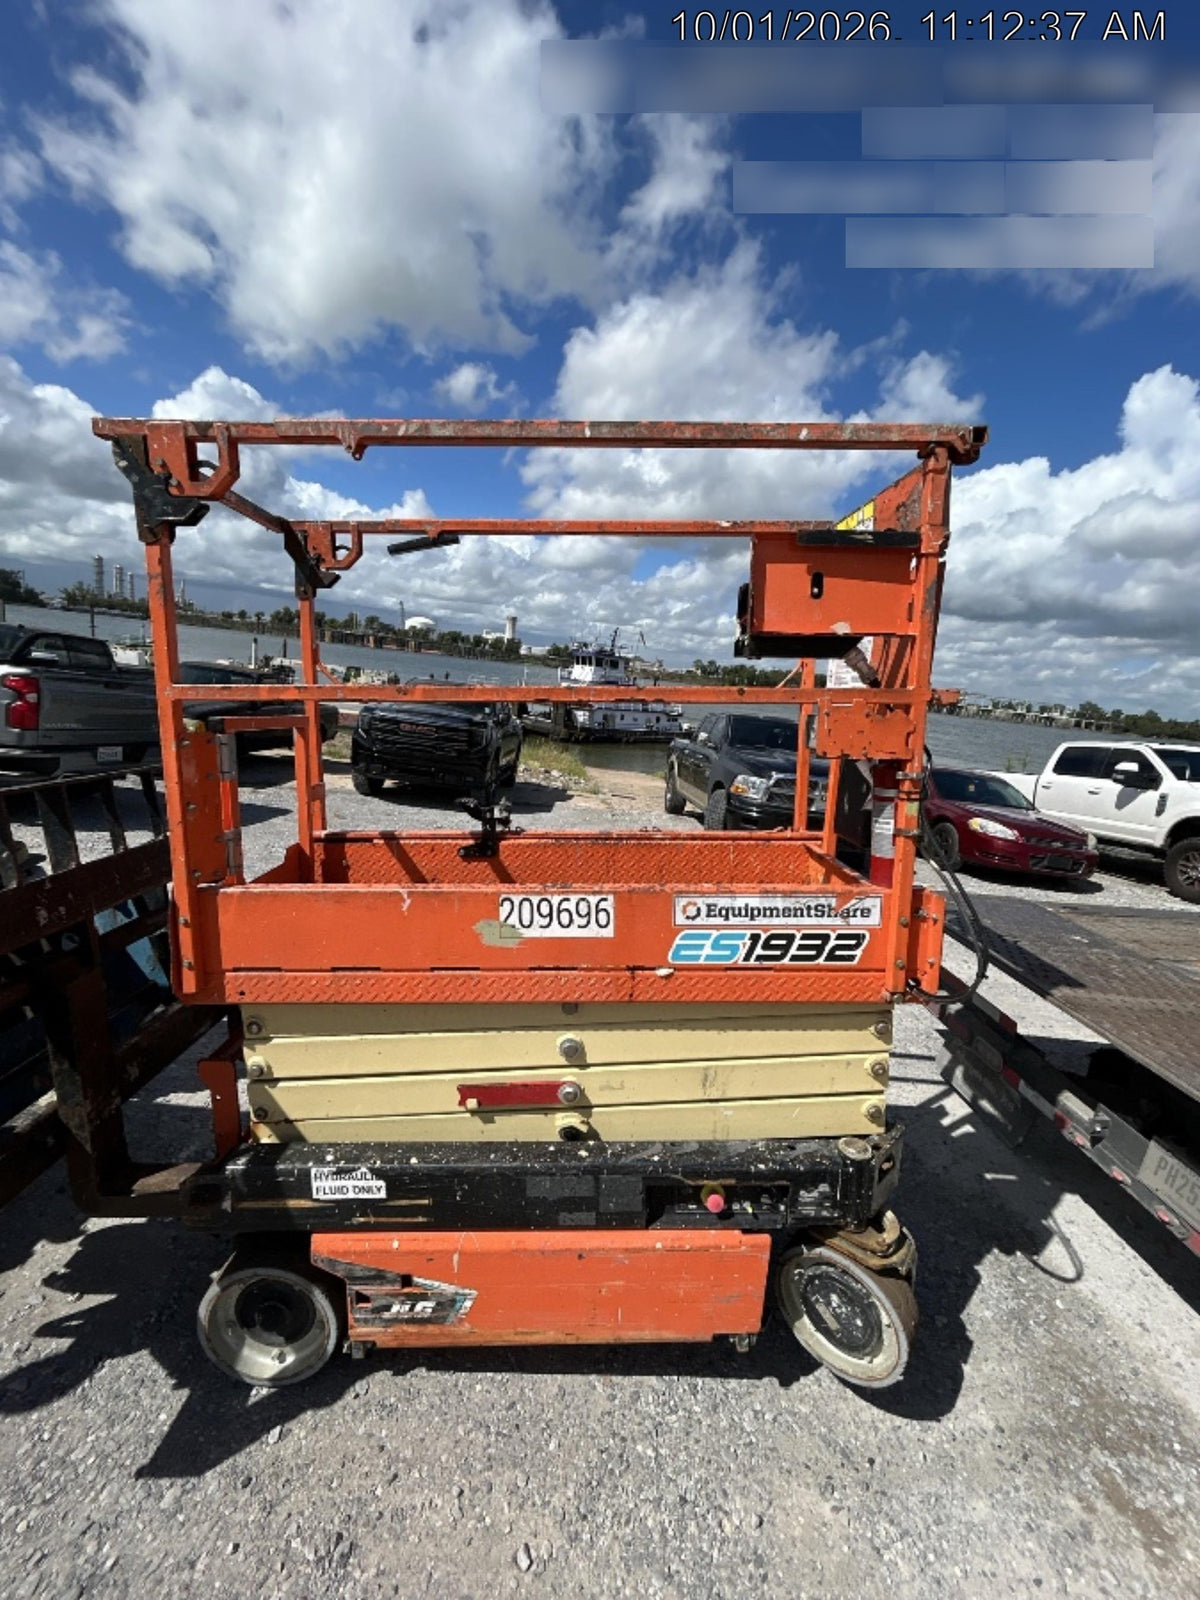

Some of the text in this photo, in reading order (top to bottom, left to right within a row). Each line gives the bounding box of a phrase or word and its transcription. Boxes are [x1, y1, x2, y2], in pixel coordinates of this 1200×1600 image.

[500, 896, 611, 929] 209696
[705, 903, 871, 921] EquipmentShare
[670, 932, 867, 963] ES1932
[316, 1185, 383, 1195] FLUID ONLY
[1153, 1155, 1200, 1213] PH25
